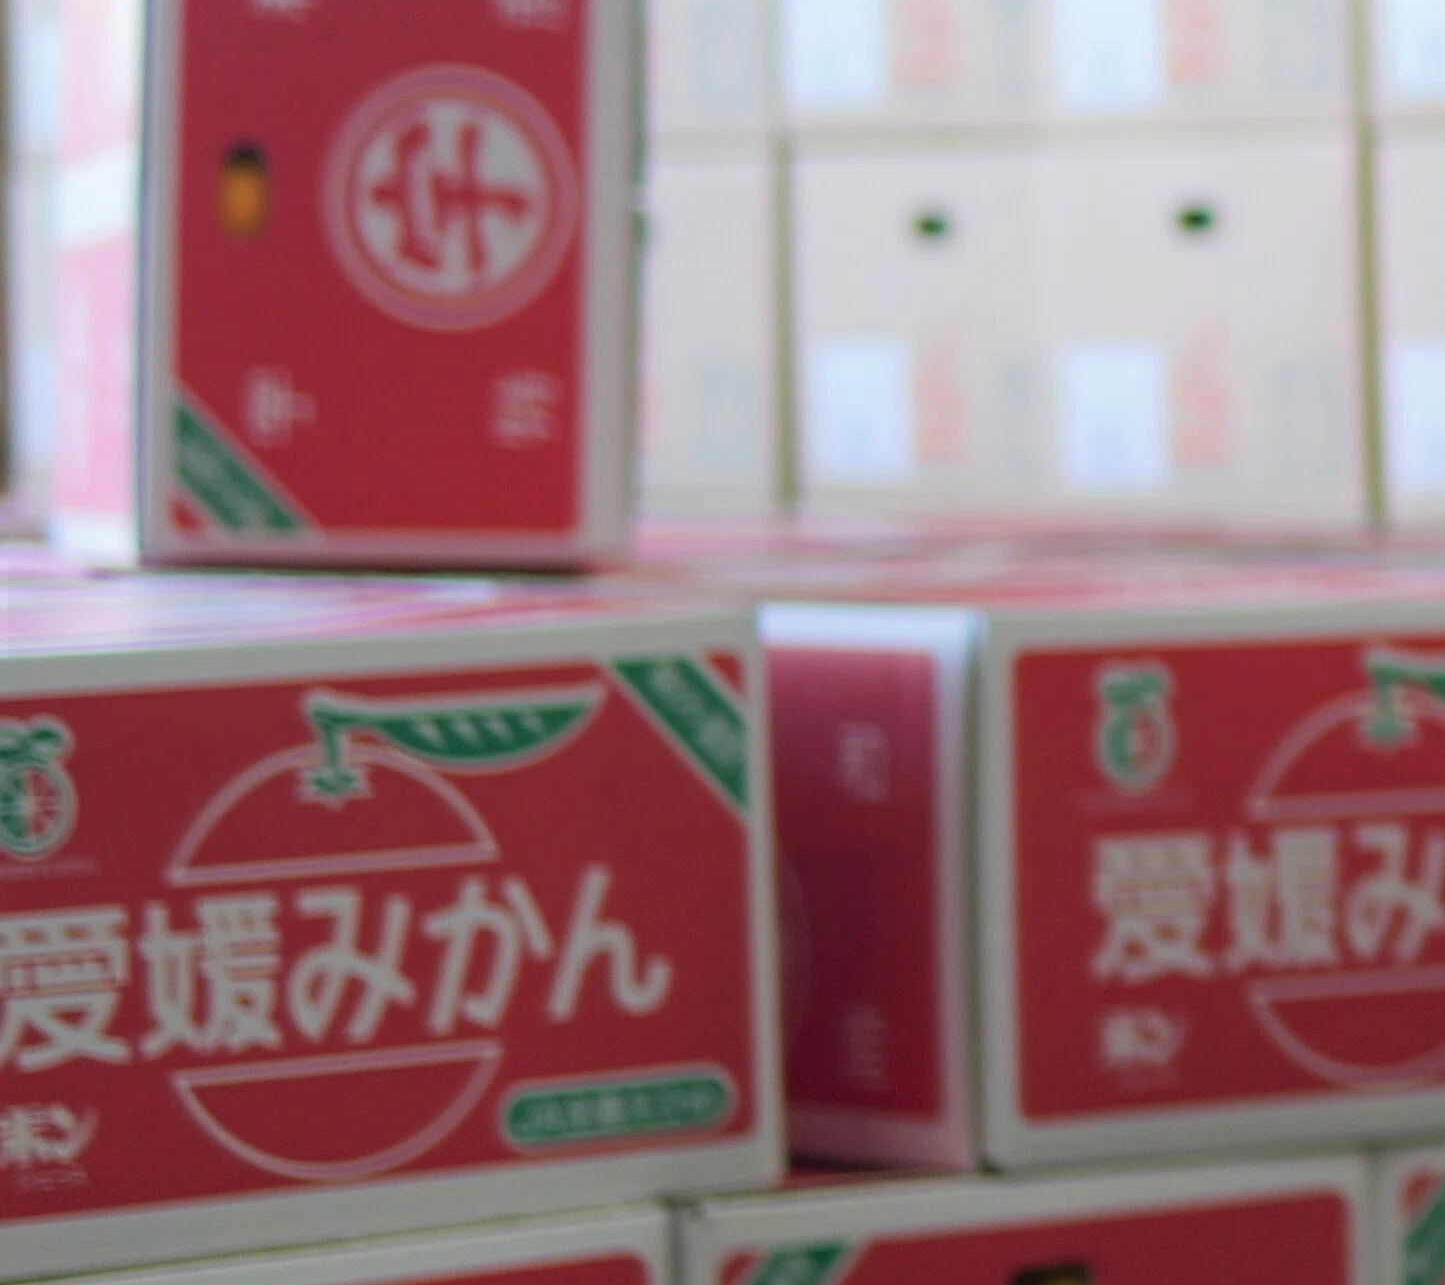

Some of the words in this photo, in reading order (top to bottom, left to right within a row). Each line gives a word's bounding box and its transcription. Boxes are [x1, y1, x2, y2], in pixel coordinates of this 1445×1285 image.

[0, 864, 671, 1072] 愛媛みかん
